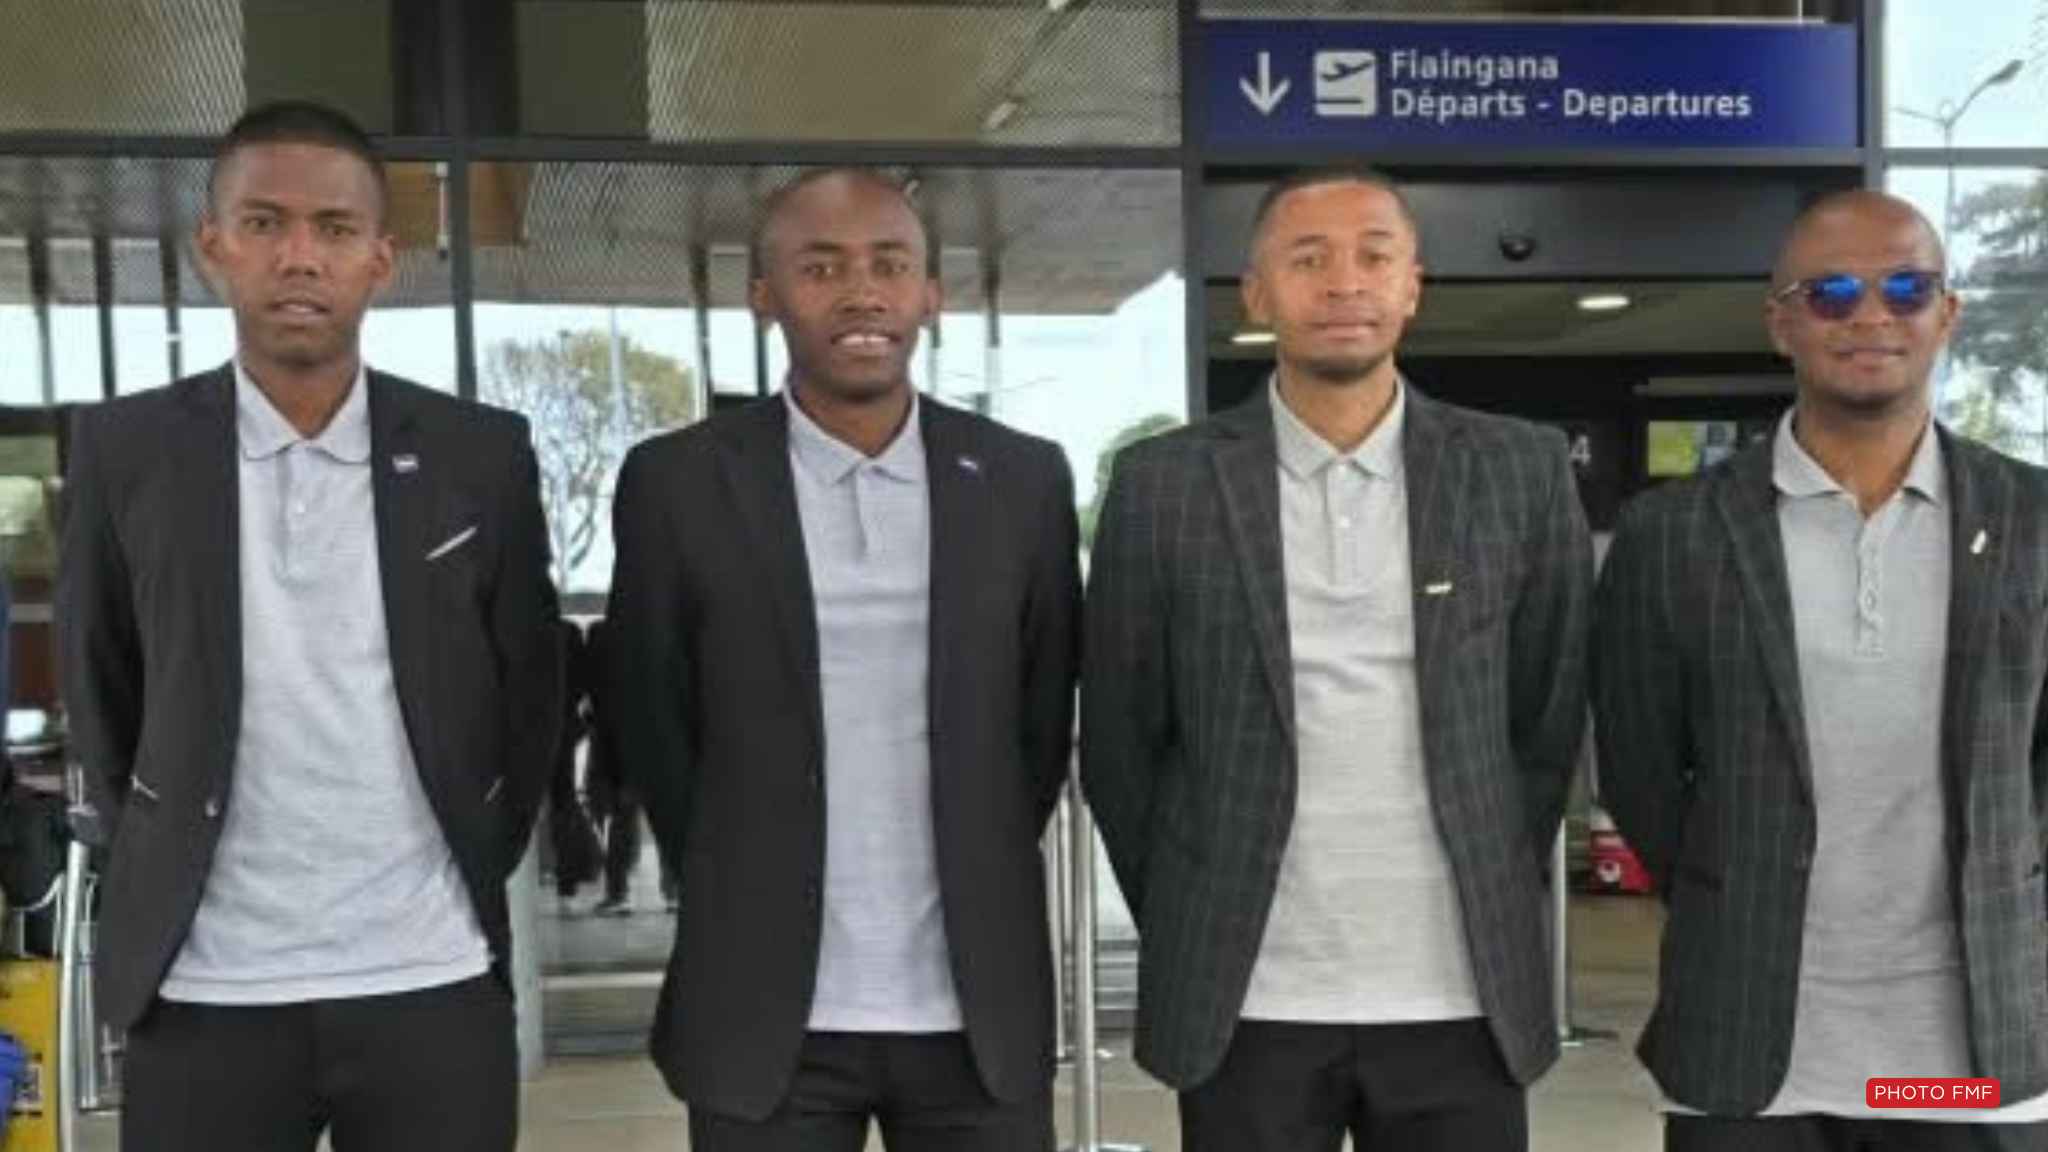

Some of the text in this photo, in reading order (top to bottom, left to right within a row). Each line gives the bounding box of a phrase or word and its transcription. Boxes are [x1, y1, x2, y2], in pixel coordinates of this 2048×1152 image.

[1392, 49, 1559, 86] Fiaingana
[1392, 87, 1526, 123] Départs
[1563, 88, 1751, 123] Departures
